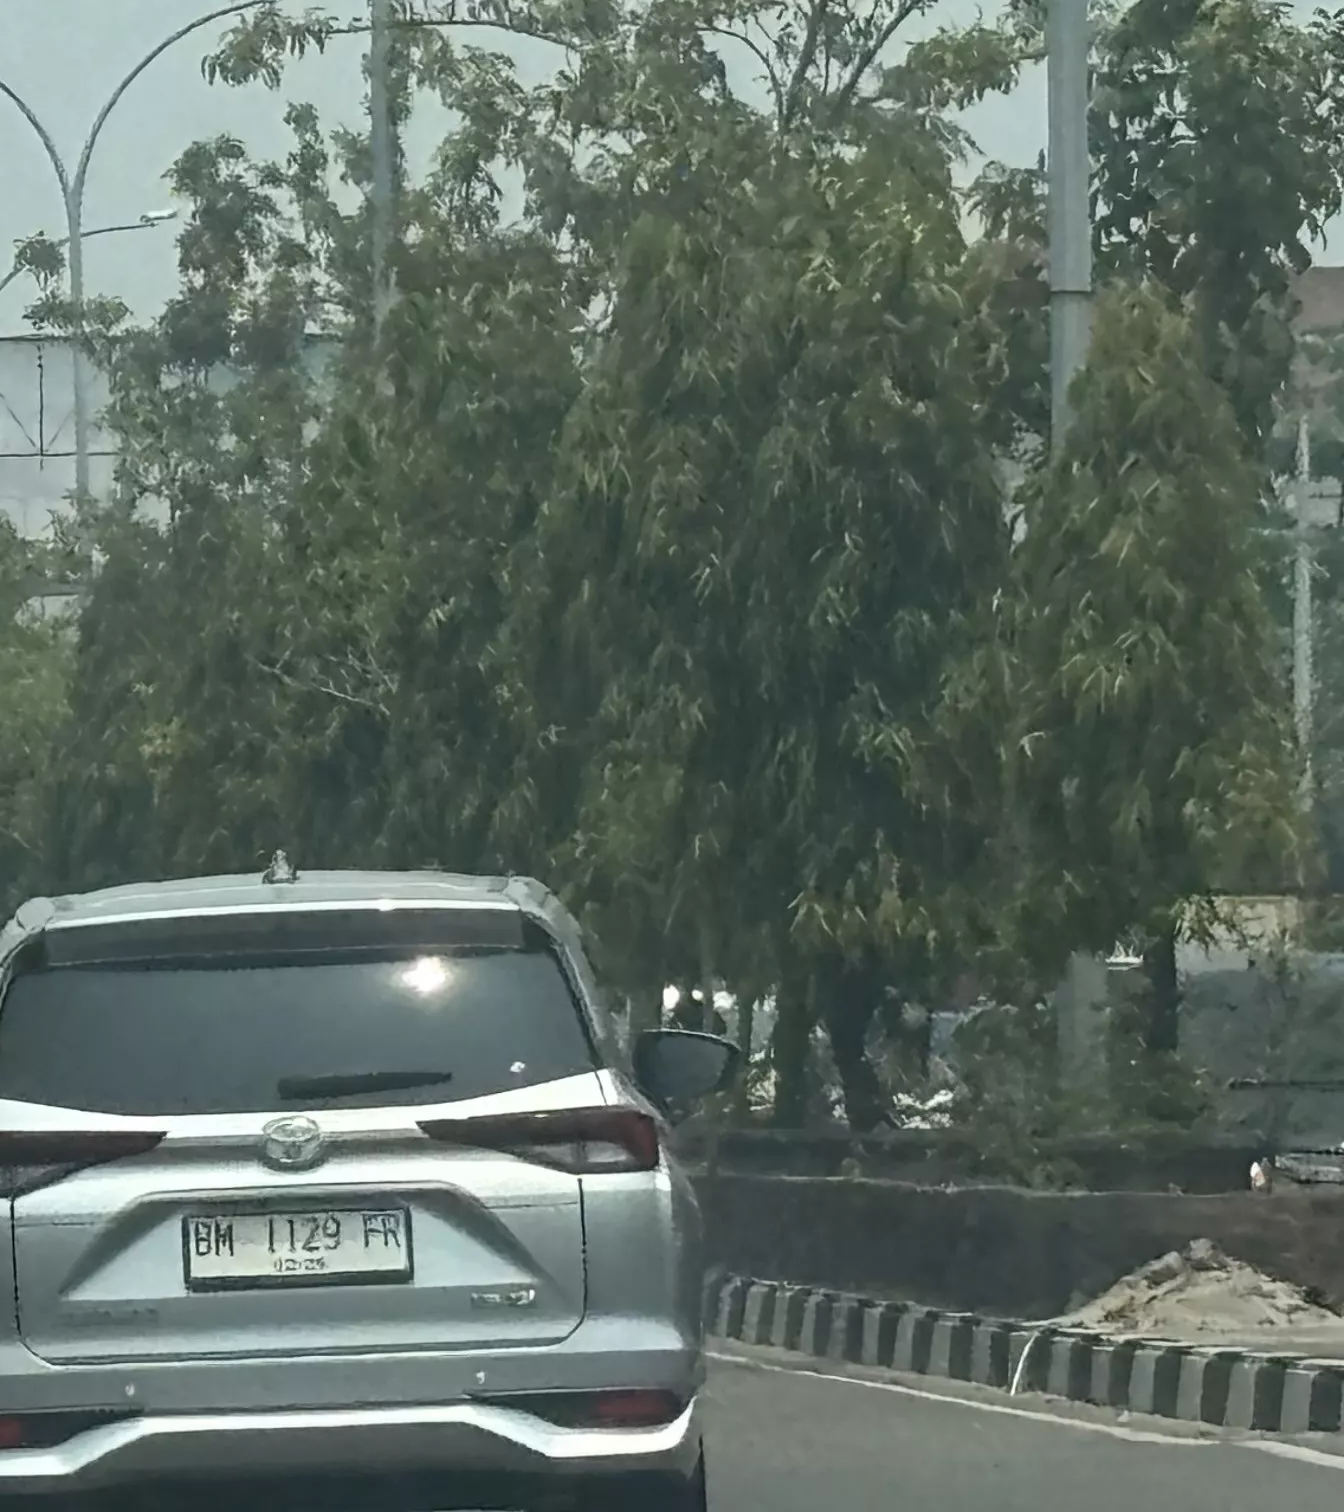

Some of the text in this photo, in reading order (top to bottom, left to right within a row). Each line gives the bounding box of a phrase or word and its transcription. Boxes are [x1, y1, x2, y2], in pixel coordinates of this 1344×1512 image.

[194, 1212, 401, 1256] BM 1129 FR
